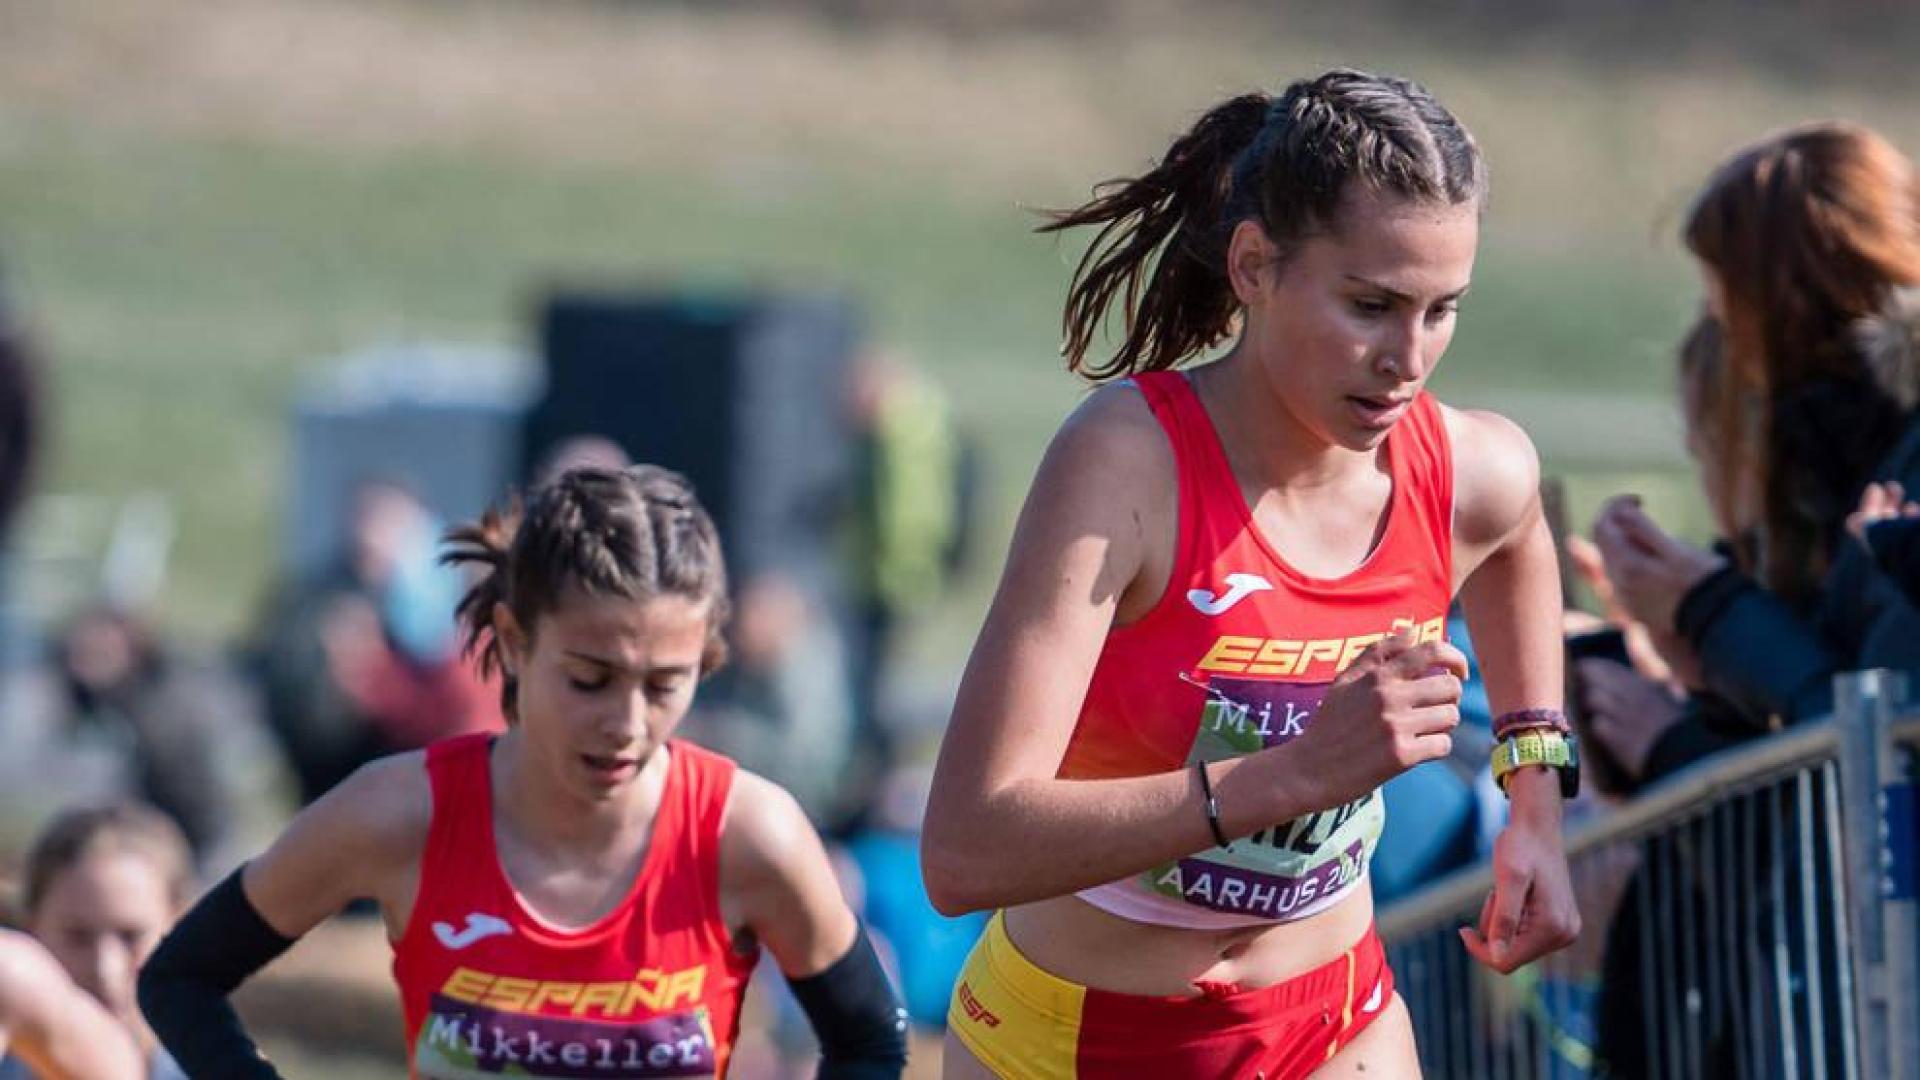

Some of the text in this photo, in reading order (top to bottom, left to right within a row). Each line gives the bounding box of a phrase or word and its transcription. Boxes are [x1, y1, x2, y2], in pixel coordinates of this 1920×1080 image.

[1158, 871, 1319, 913] AARHUS
[442, 966, 707, 1015] ESPAÑA
[958, 981, 1001, 1028] ESP
[428, 1013, 705, 1069] Mikkeller
